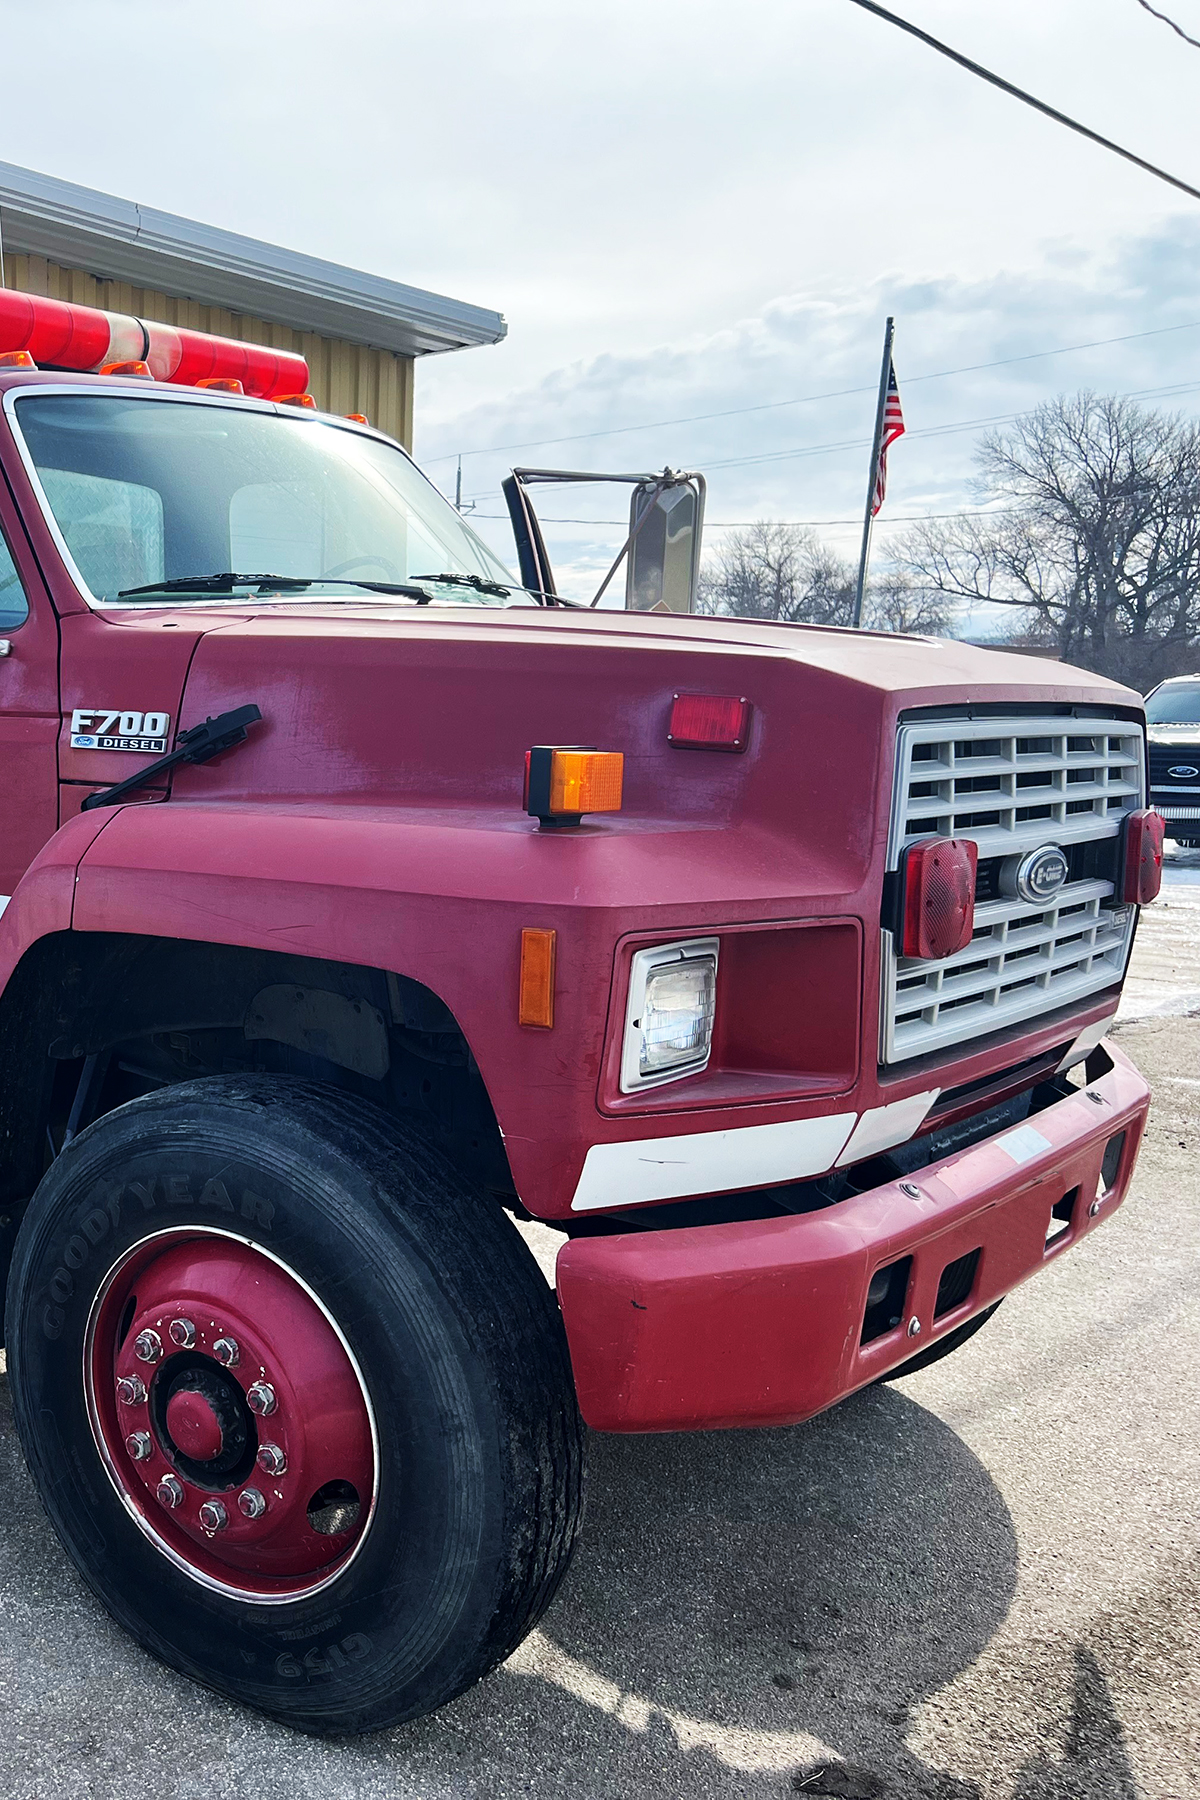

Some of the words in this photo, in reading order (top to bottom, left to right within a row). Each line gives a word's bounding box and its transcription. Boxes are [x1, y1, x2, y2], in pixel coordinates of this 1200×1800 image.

[70, 709, 171, 737] F700
[103, 739, 160, 751] DIESEL
[274, 1632, 375, 1682] G159
